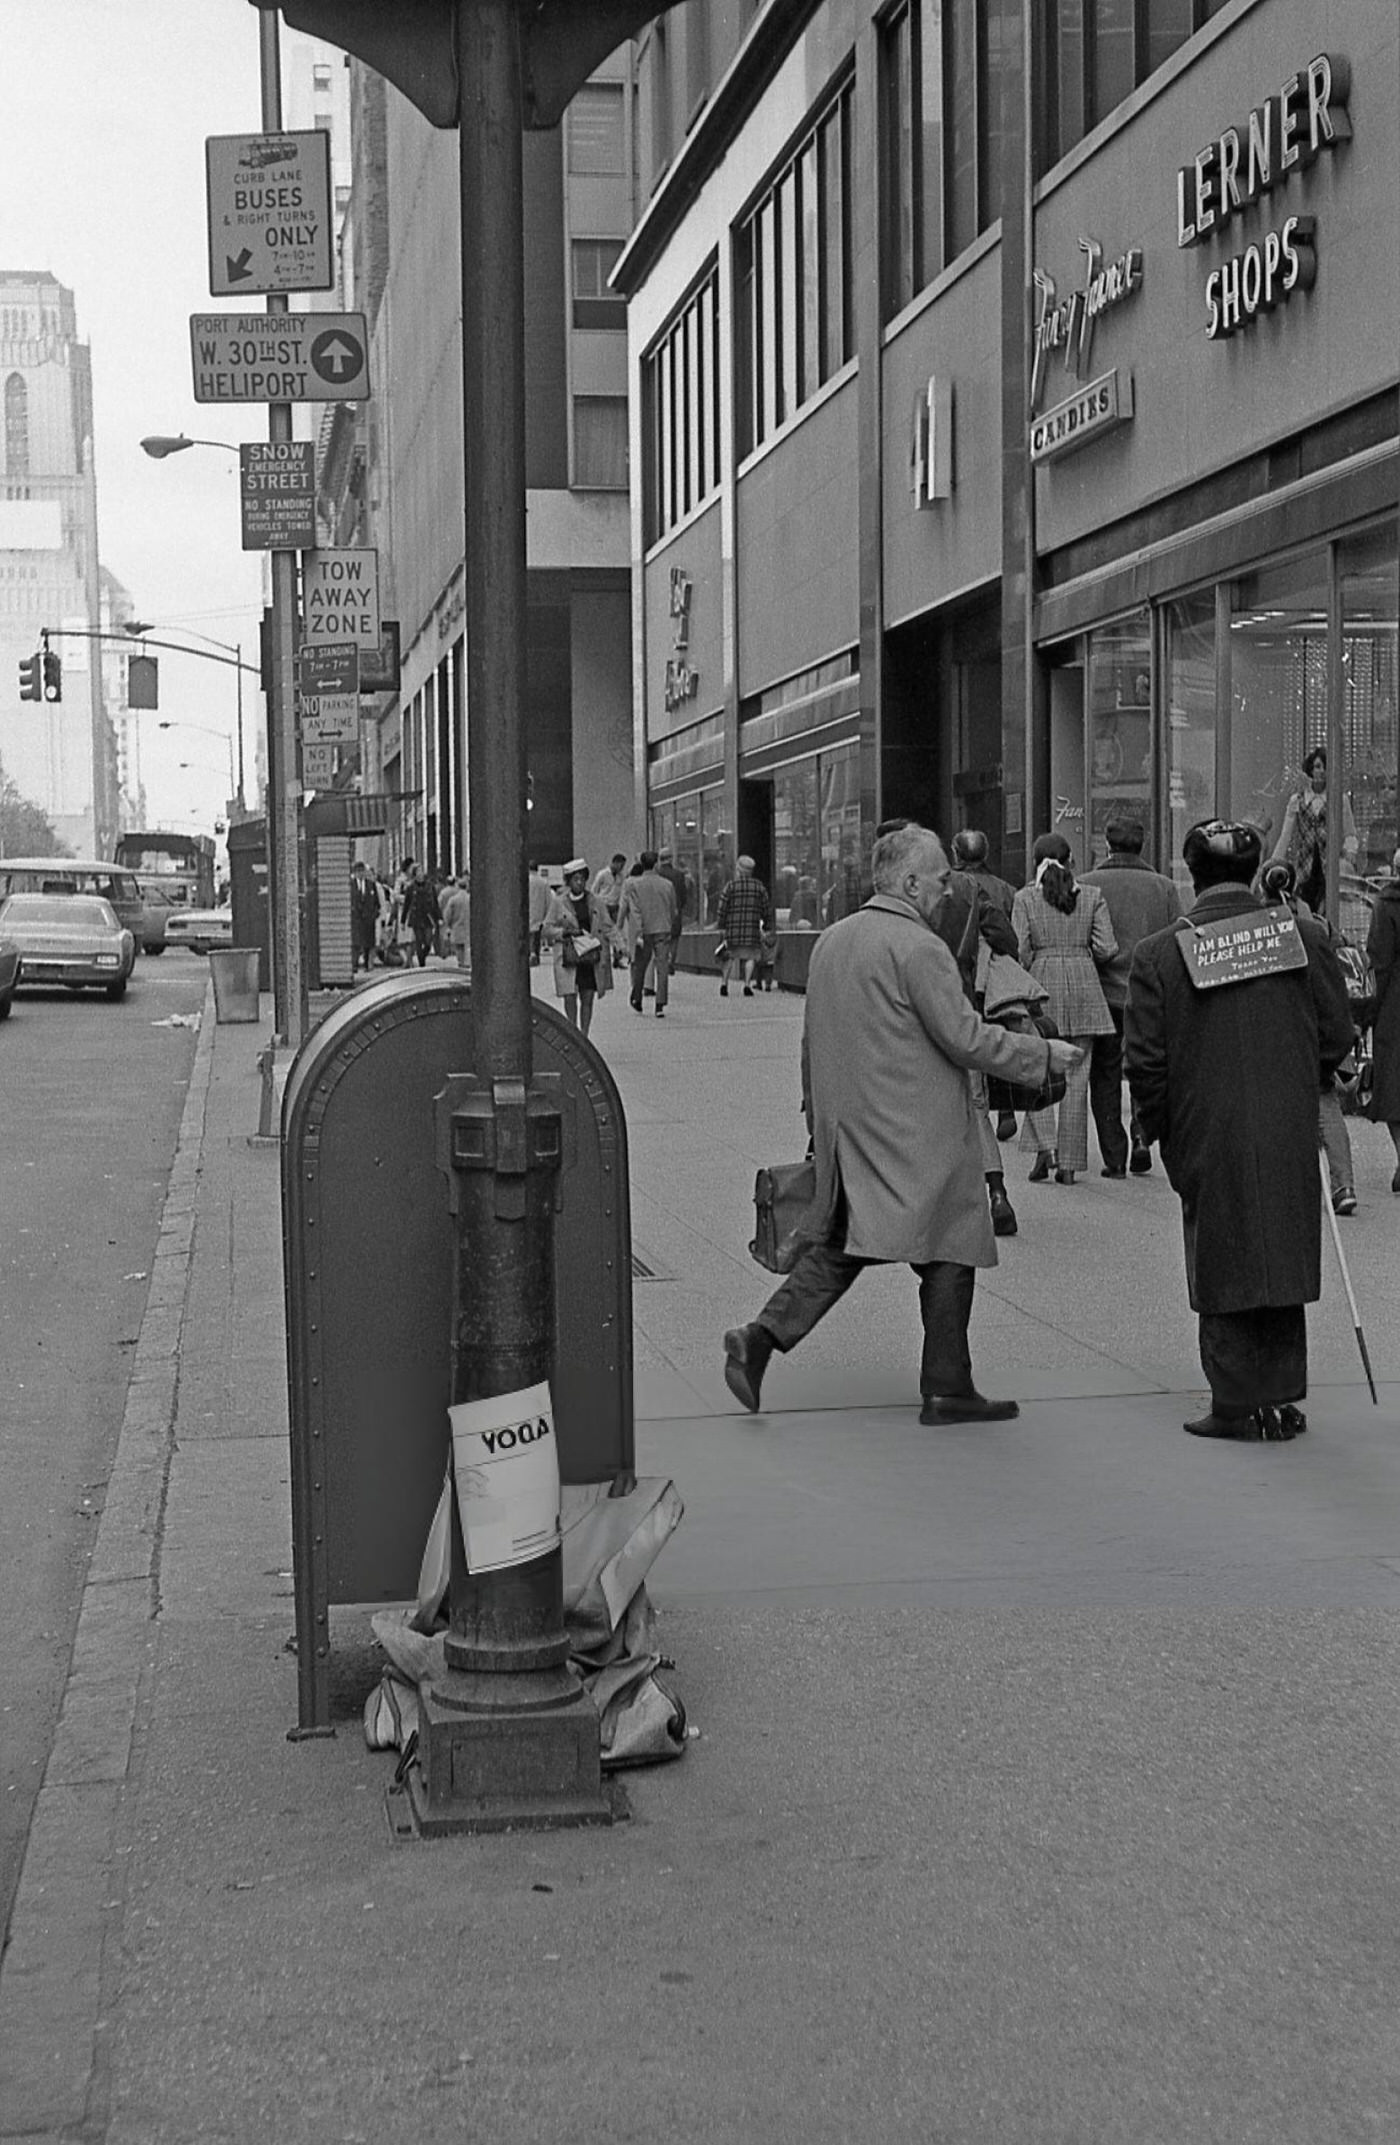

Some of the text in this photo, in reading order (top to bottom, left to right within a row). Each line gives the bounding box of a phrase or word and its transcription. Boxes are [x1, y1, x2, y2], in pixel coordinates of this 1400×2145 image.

[1178, 53, 1340, 248] LERNER
[234, 169, 302, 184] CURB LANE
[235, 187, 302, 210] BUSES
[223, 209, 316, 226] & RIGHT TURNS
[265, 225, 318, 247] ONLY
[1205, 215, 1303, 340] SHOPS
[195, 317, 306, 333] PORT AUTHORITY
[200, 341, 222, 365] W.
[278, 340, 307, 365] ST.
[200, 372, 308, 397] HELIPORT
[1033, 386, 1109, 451] CANDIES
[250, 444, 305, 460] SNOW
[248, 460, 306, 472] EMERGENCY
[247, 473, 309, 489] STREET
[244, 498, 312, 511] NO STANDING
[318, 561, 361, 580] TOW
[310, 588, 371, 607] AWAY
[311, 614, 372, 634] ZONE
[303, 644, 356, 660] NO STANDING
[302, 696, 355, 716] NO PARKING
[308, 717, 353, 729] ANY TIME
[309, 749, 325, 760] NO
[305, 763, 327, 773] LEFT
[305, 775, 329, 785] TURN
[1192, 919, 1295, 955] I AM BLIND WILL YOU
[1198, 936, 1282, 967] PLEASE HELP ME
